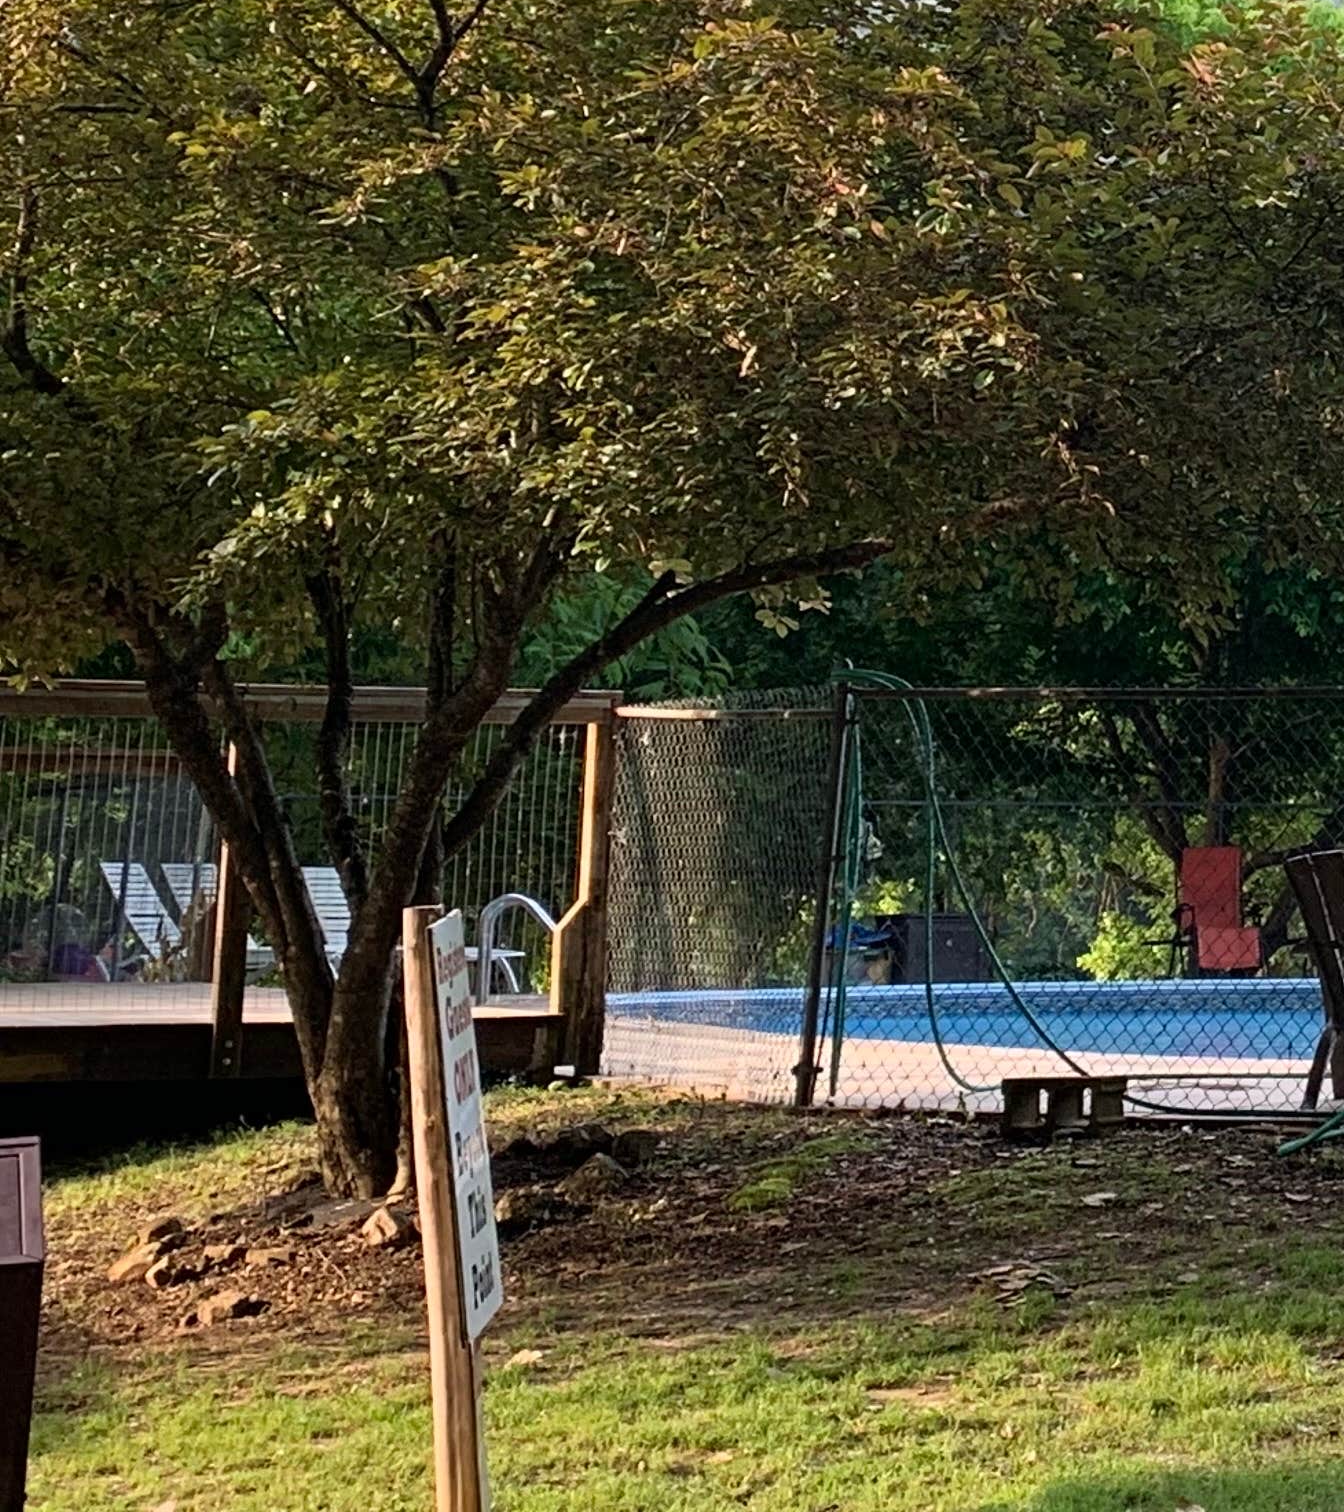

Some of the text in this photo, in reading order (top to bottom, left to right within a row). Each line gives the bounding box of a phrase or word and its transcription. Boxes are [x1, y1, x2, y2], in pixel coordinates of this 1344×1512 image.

[454, 1049, 476, 1104] ONLY
[468, 1186, 487, 1239] This
[472, 1251, 495, 1310] Point
